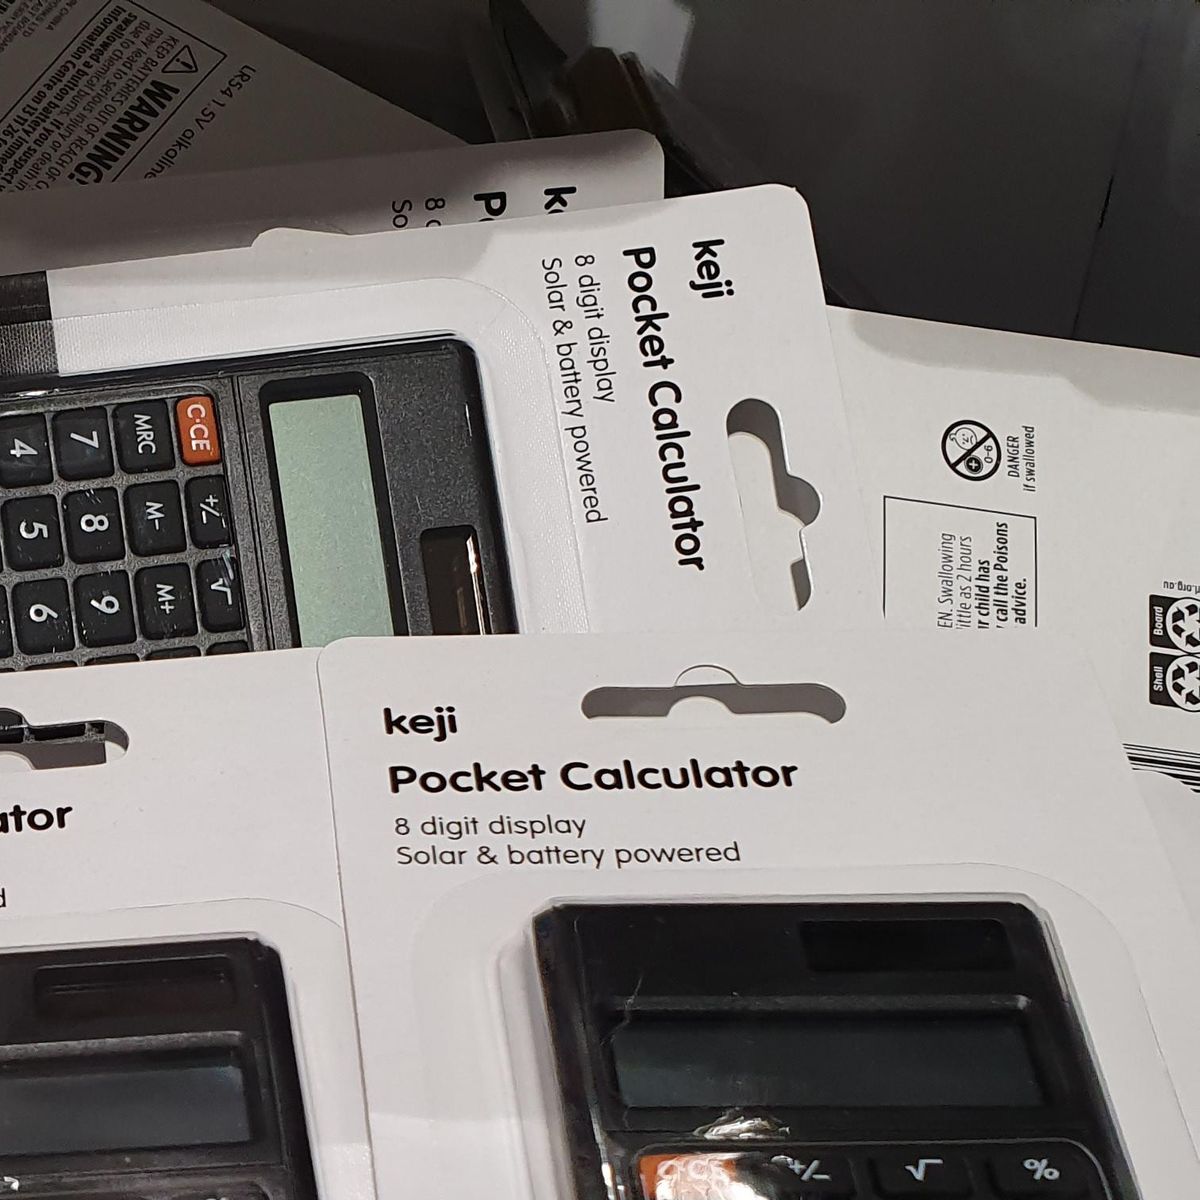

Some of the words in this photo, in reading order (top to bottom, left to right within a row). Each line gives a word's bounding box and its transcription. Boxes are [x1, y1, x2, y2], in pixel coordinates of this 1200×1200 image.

[70, 5, 126, 60] Information
[89, 12, 137, 63] swallowed
[129, 19, 150, 38] due
[140, 27, 163, 49] may
[119, 37, 135, 49] to
[154, 35, 179, 59] KEEP
[81, 60, 93, 69] a
[84, 48, 123, 90] chemical
[121, 47, 147, 71] lead
[43, 59, 76, 90] Centre
[53, 68, 89, 101] button
[110, 57, 158, 105] BATTERIES
[112, 68, 128, 80] to
[220, 64, 256, 98] LR54
[21, 103, 38, 117] 13
[31, 89, 46, 104] on
[56, 88, 90, 116] burns.
[82, 79, 116, 113] serious
[12, 114, 28, 126] 11
[21, 100, 60, 137] battery
[49, 118, 64, 130] If
[57, 112, 87, 140] injury
[93, 103, 116, 125] OUT
[1, 123, 20, 139] 26
[32, 126, 54, 147] you
[68, 80, 179, 184] WARNING!
[83, 122, 99, 139] OF
[49, 140, 62, 152] or
[54, 135, 88, 168] REACH
[143, 128, 194, 178] alkaline
[0, 145, 37, 184] suspect
[23, 151, 51, 180] death
[44, 166, 61, 182] OF
[14, 179, 30, 191] in
[474, 191, 507, 221] P
[544, 186, 576, 214] k
[574, 254, 595, 268] 8
[689, 239, 734, 299] keji
[541, 257, 567, 311] Solar
[576, 274, 604, 321] digit
[622, 246, 675, 370] Pocket
[552, 320, 573, 336] &
[587, 326, 615, 403] display
[556, 341, 585, 418] battery
[9, 437, 37, 458] 4
[70, 430, 98, 449] 7
[1022, 425, 1036, 482] swallowed
[1007, 436, 1020, 478] DANGER
[564, 425, 608, 524] powered
[648, 381, 705, 572] Calculator
[1023, 483, 1036, 492] if
[80, 513, 109, 532] 8
[133, 414, 156, 455] MRC
[156, 583, 175, 615] M+
[20, 520, 48, 539] 5
[959, 535, 972, 569] hours
[994, 521, 1008, 573] Poisons
[937, 532, 956, 604] Swallowing
[957, 571, 971, 581] 2
[975, 558, 990, 579] has
[960, 581, 972, 594] as
[993, 575, 1008, 597] the
[29, 603, 58, 622] 6
[90, 595, 119, 614] 9
[975, 584, 990, 617] child
[993, 599, 1008, 624] call
[1011, 577, 1027, 625] advice.
[1153, 606, 1163, 636] Board
[1153, 666, 1163, 691] Shell
[383, 706, 458, 742] keji
[388, 762, 546, 794] Pocket
[560, 758, 798, 791] Calculator
[394, 816, 410, 836] 8
[421, 815, 479, 840] digit
[488, 814, 586, 839] display
[397, 844, 467, 866] Solar
[477, 846, 497, 865] &
[507, 843, 605, 870] battery
[615, 840, 741, 869] powered
